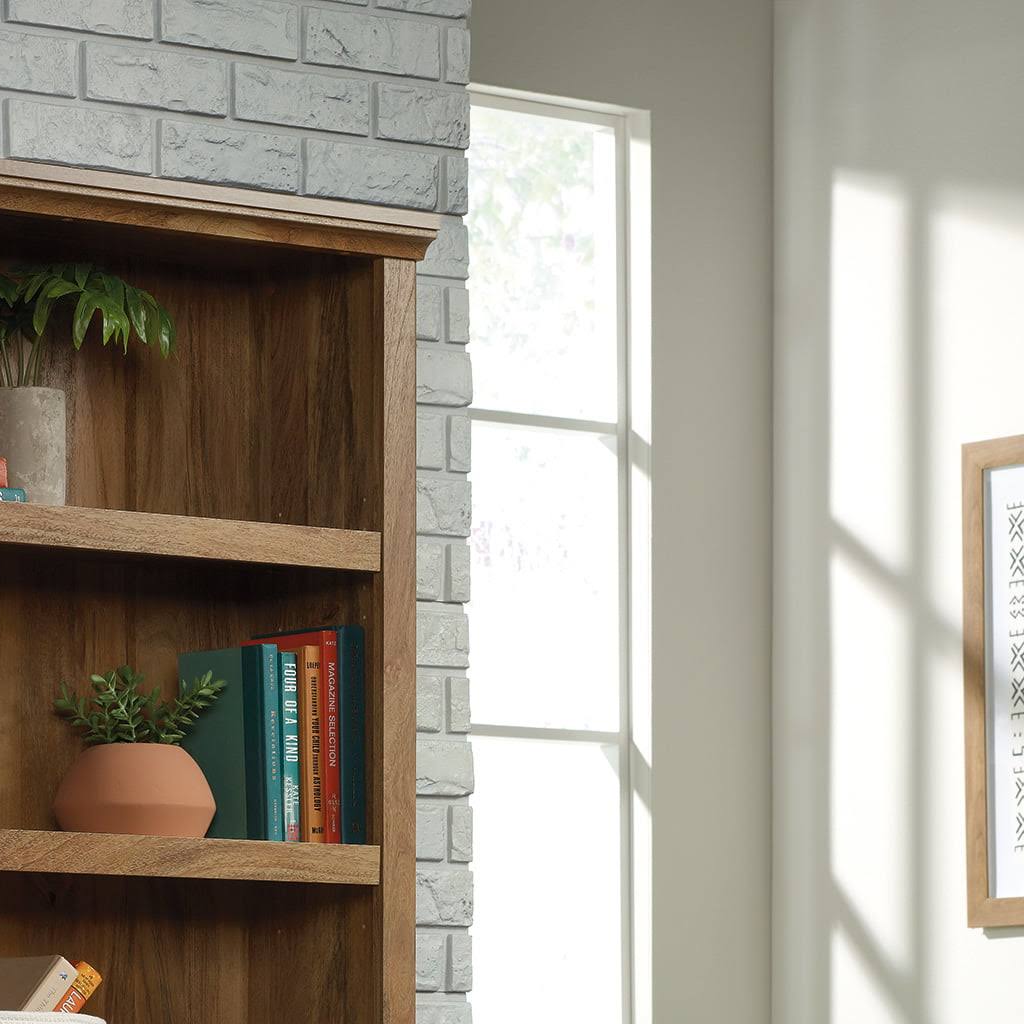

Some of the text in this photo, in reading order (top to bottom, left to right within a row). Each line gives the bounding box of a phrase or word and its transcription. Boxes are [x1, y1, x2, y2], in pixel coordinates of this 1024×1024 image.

[284, 663, 297, 692] FOUR
[284, 701, 297, 714] OF
[328, 662, 337, 767] MAGAZINE SELECTION
[285, 735, 298, 762] KIND
[312, 735, 320, 753] CHILD
[313, 776, 321, 812] ASTROLOGY
